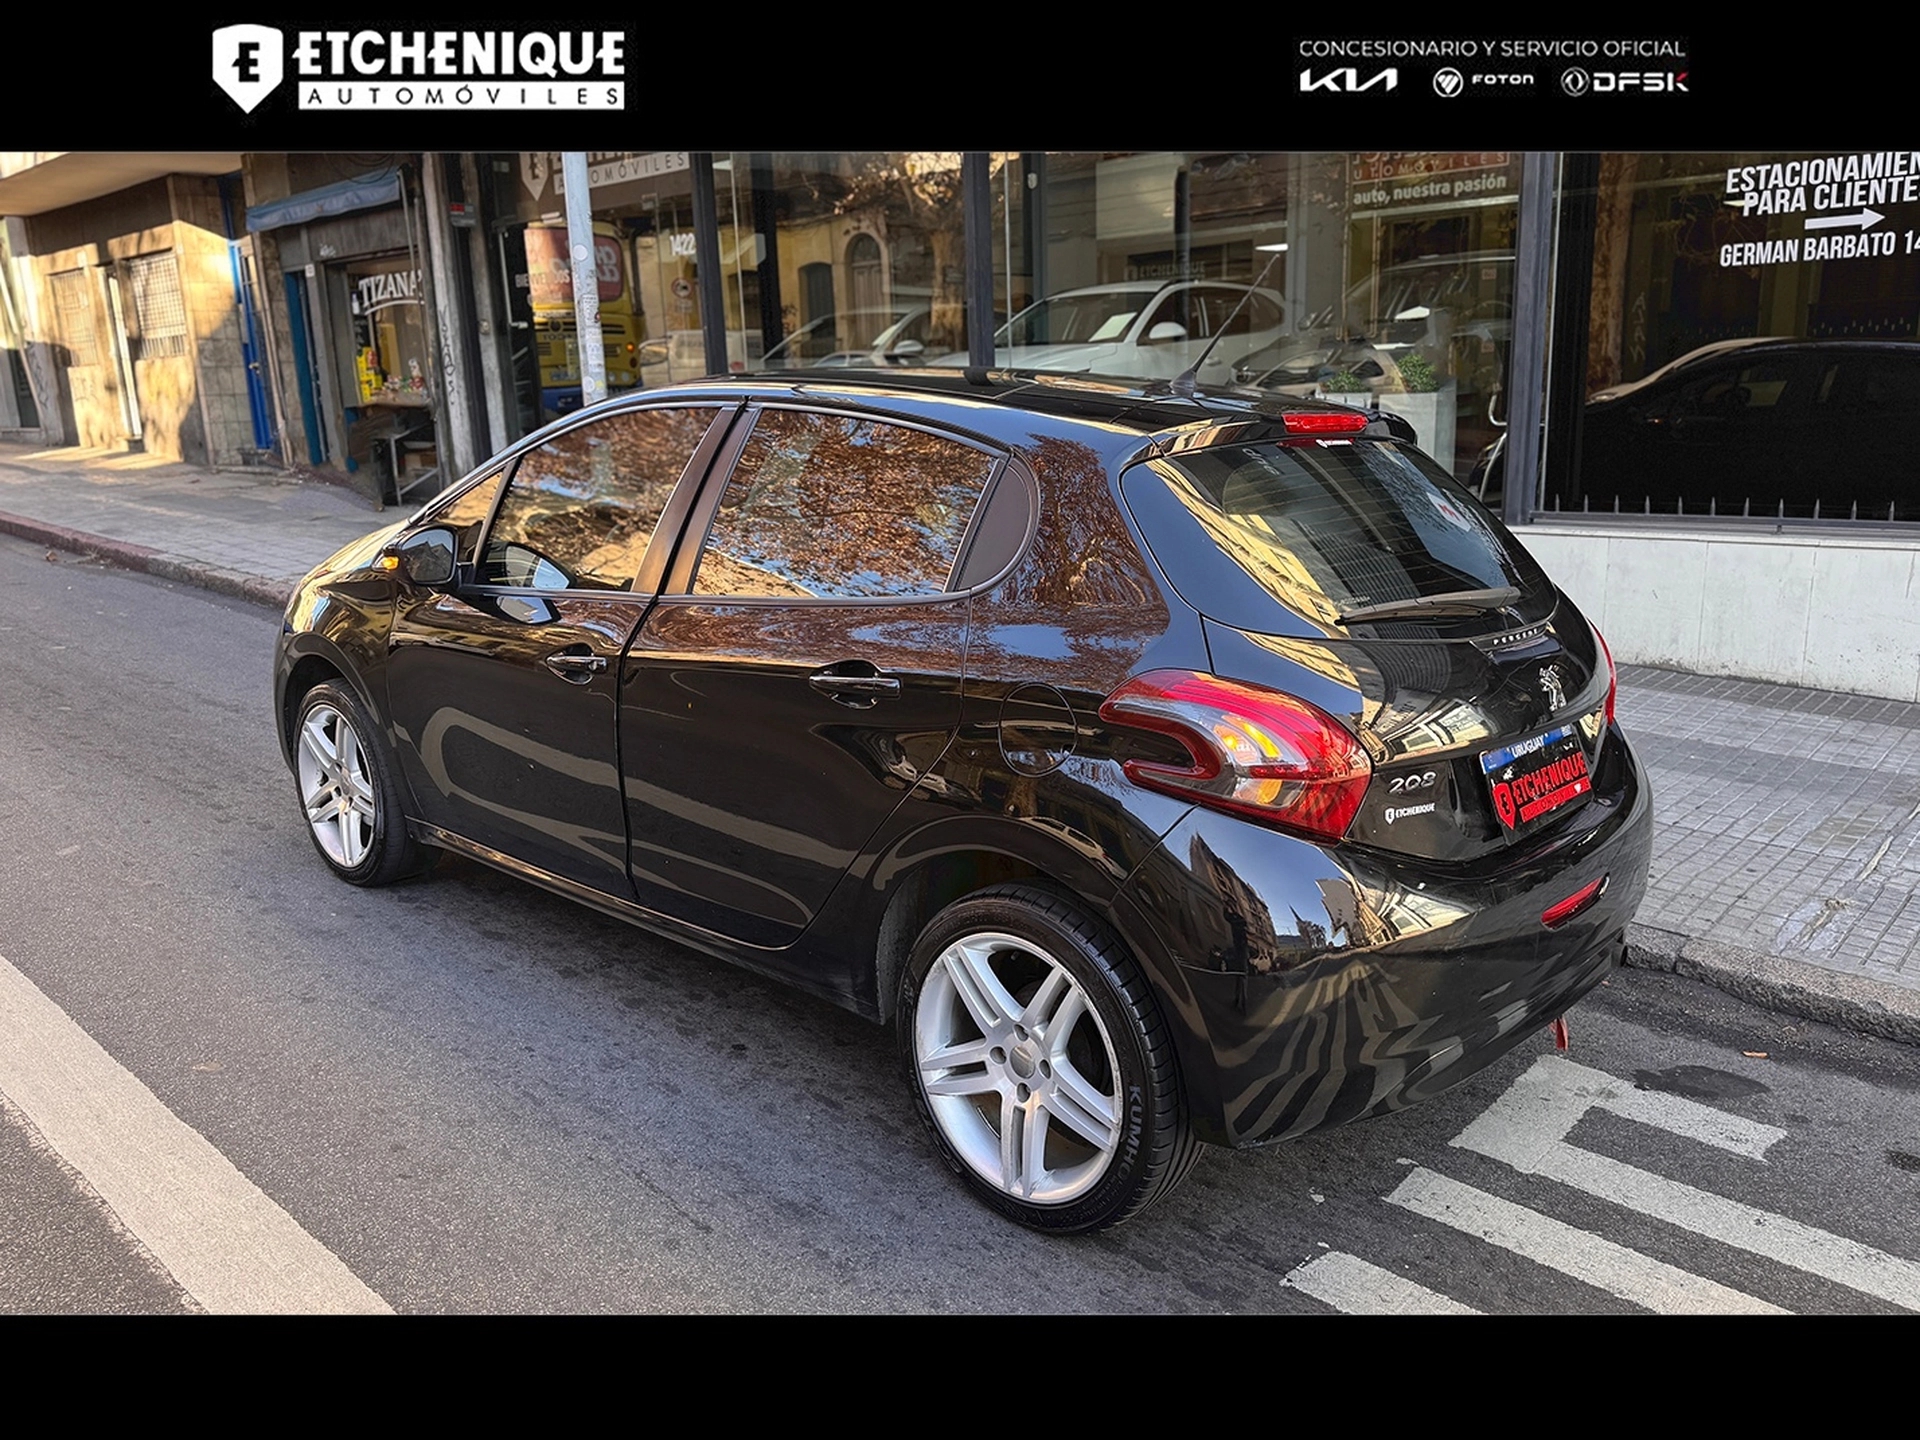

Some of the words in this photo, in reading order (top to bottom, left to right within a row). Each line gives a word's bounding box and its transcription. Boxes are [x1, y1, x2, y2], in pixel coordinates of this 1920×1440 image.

[557, 153, 685, 189] AOMÓVILES
[1353, 188, 1391, 205] auto,
[1393, 182, 1451, 201] nuestra
[1454, 172, 1507, 197] pasión
[1743, 187, 1807, 217] PARA
[1813, 175, 1920, 210] CLIENTE
[669, 232, 697, 256] 1422
[1719, 239, 1799, 267] GERMAN
[1803, 231, 1896, 261] BARBATO
[1513, 736, 1545, 758] URUGUAY
[1388, 771, 1437, 795] 208
[1511, 751, 1587, 805] ETCHENIQUE
[1120, 1085, 1142, 1182] KUMHO
